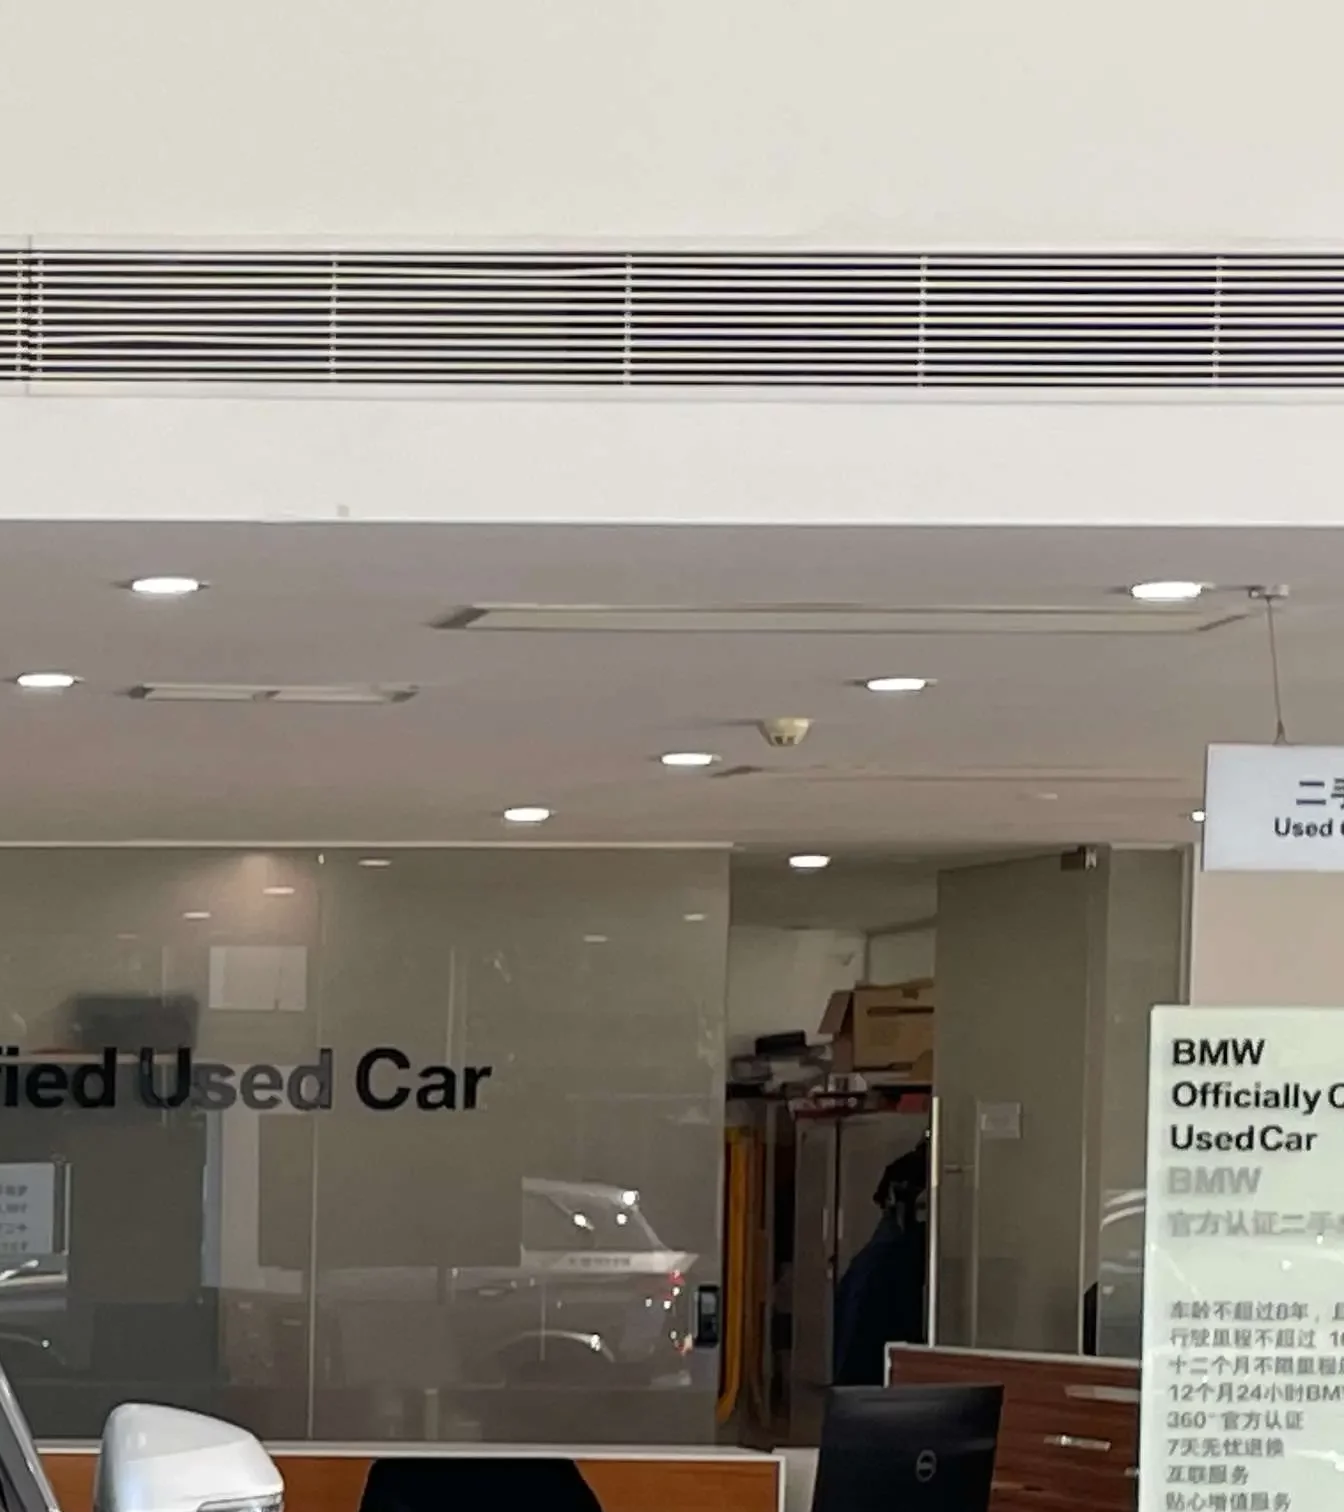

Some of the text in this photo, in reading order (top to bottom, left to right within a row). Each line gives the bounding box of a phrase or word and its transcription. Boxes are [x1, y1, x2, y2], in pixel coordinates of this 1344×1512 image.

[1274, 816, 1334, 838] Used
[1172, 1038, 1266, 1066] BMW
[138, 1046, 333, 1112] Used
[355, 1047, 493, 1111] Car
[1171, 1080, 1322, 1116] Officially
[1170, 1124, 1319, 1151] Used Car
[1167, 1166, 1263, 1195] BMW
[1168, 1381, 1344, 1404] 12个月24小时BM
